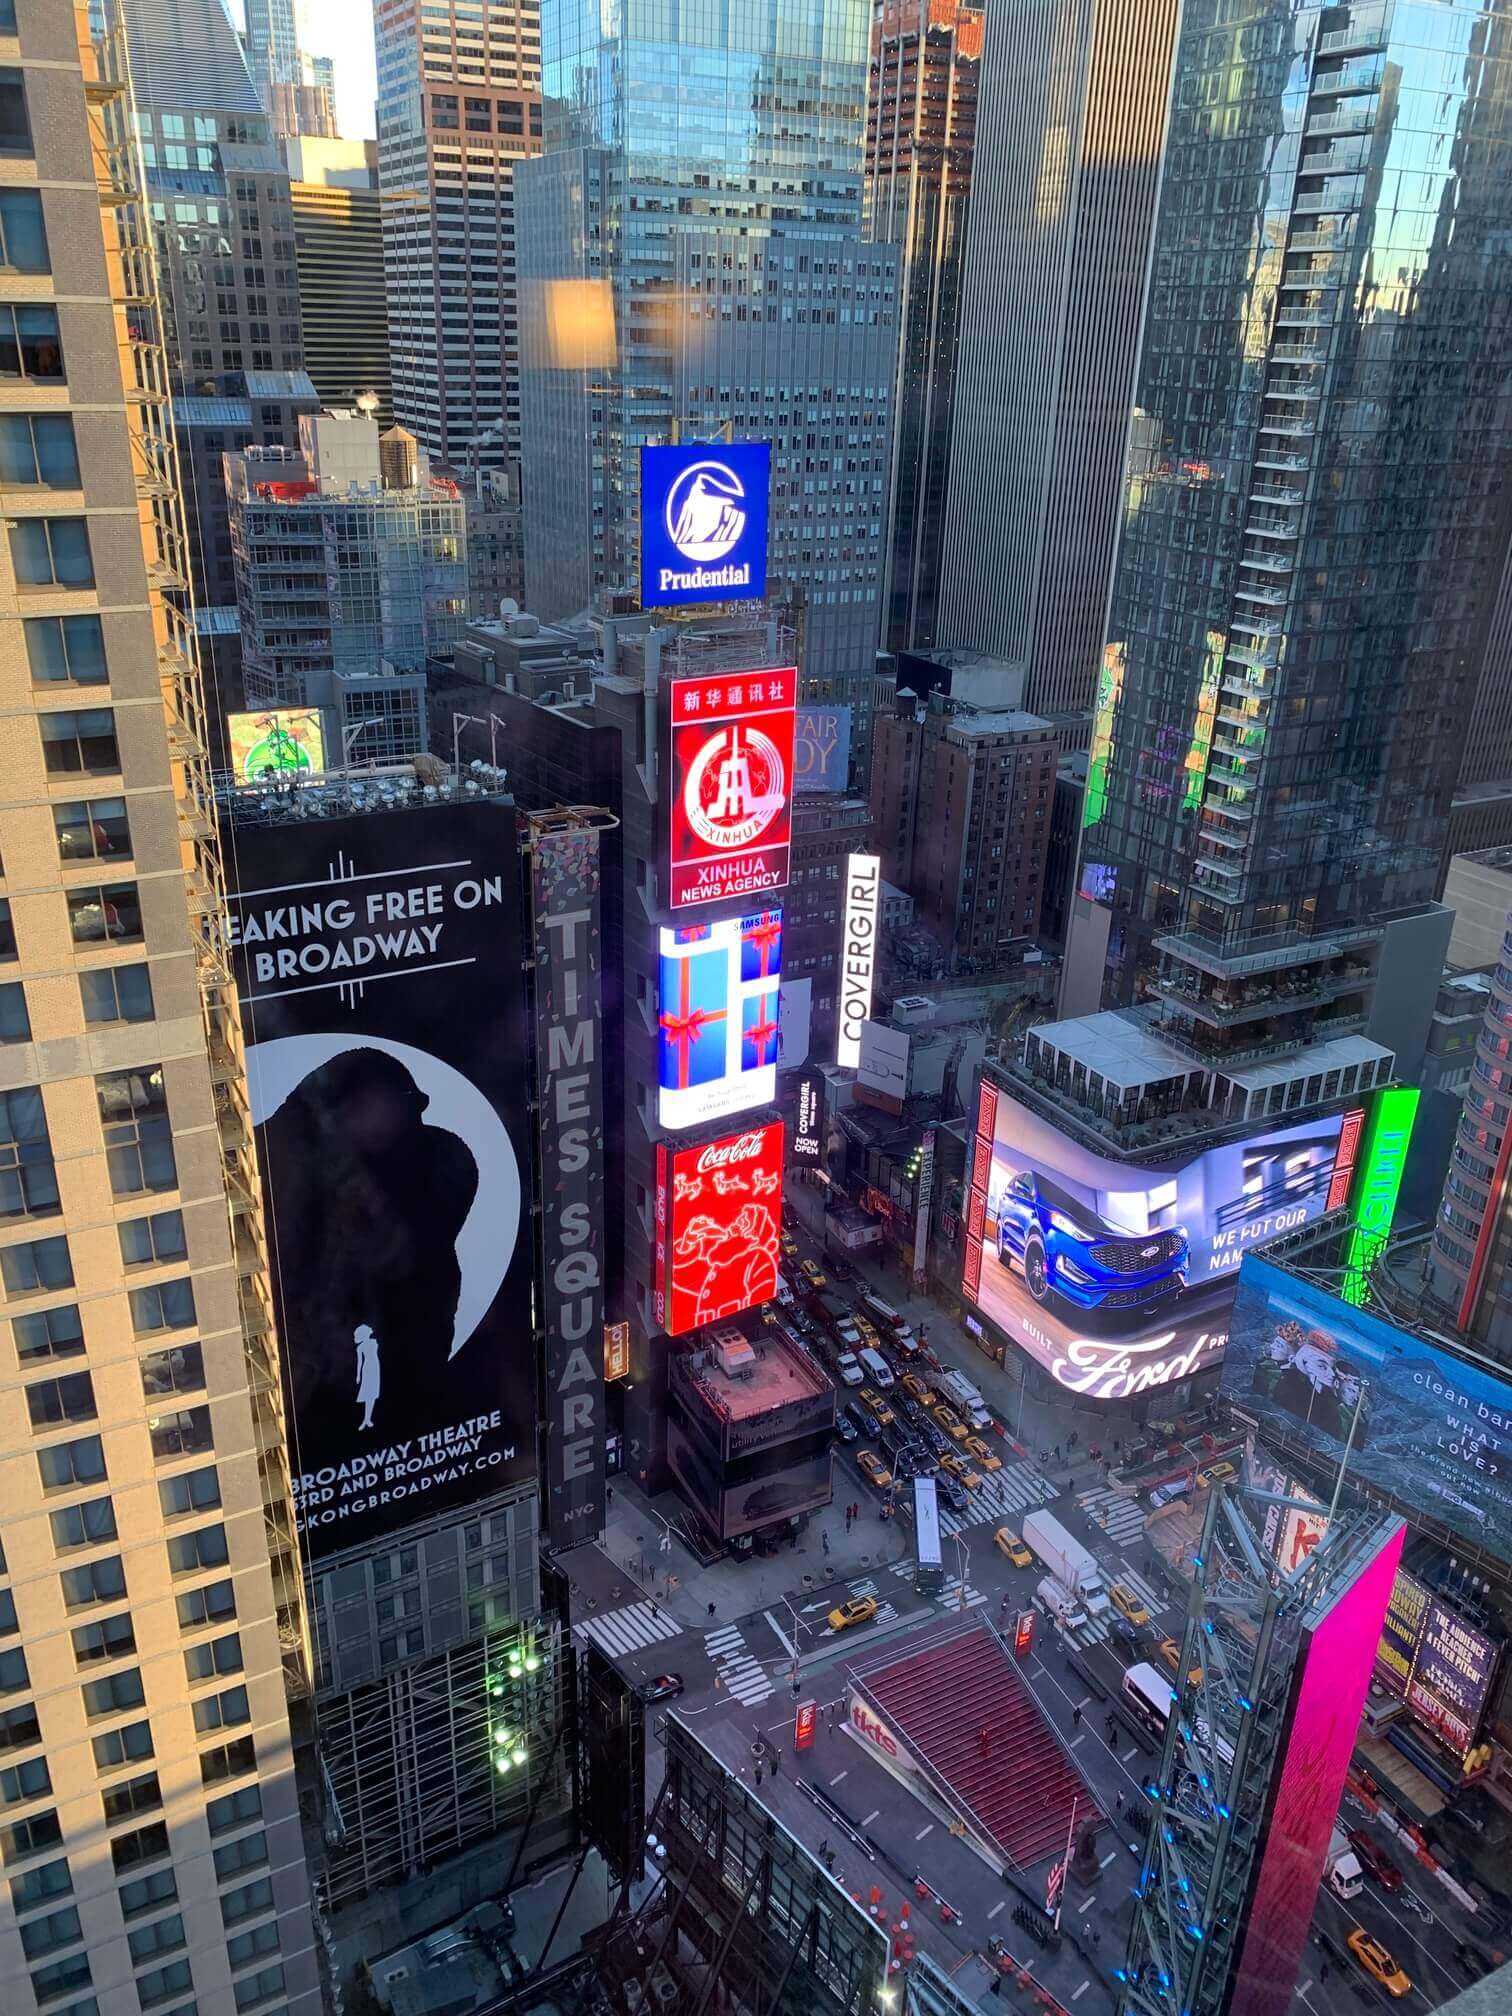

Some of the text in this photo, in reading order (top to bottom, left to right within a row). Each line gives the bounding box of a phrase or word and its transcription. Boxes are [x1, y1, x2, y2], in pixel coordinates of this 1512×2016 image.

[660, 562, 750, 591] Prudential
[683, 681, 785, 711] 新华通讯社
[706, 819, 763, 844] XINHUA
[681, 870, 781, 903] NEWS AGENCY
[697, 857, 765, 885] XINHUA
[224, 876, 503, 947] EAKING FREE ON
[734, 913, 779, 931] SAMSUNG
[255, 923, 444, 983] BROADWAY
[844, 866, 876, 1042] COVERGIRL
[545, 908, 596, 1173] TIMES
[799, 1081, 811, 1134] COVERGIRL
[794, 1144, 819, 1156] OPEN
[796, 1136, 819, 1148] NOW
[1212, 1208, 1307, 1250] WE PUT OUR
[553, 1202, 600, 1482] SQUARE
[1022, 1318, 1053, 1350] BUILT
[1052, 1331, 1209, 1398] Ford
[1413, 1372, 1469, 1408] clean
[1446, 1414, 1501, 1450] WHAT
[1460, 1436, 1479, 1453] IS
[291, 1410, 502, 1494] BROADWAY THEATRE
[340, 1473, 378, 1497] AND
[384, 1435, 482, 1481] BROADWAY
[1437, 1436, 1498, 1475] LOVE?
[564, 1503, 595, 1523] NYC
[1426, 1632, 1433, 1645] A
[1433, 1636, 1456, 1664] FEVER
[1440, 1628, 1473, 1664] REACHES
[1449, 1623, 1487, 1661] AUDIENCE
[1411, 1686, 1445, 1719] JERSEY
[852, 1704, 898, 1758] tkts
